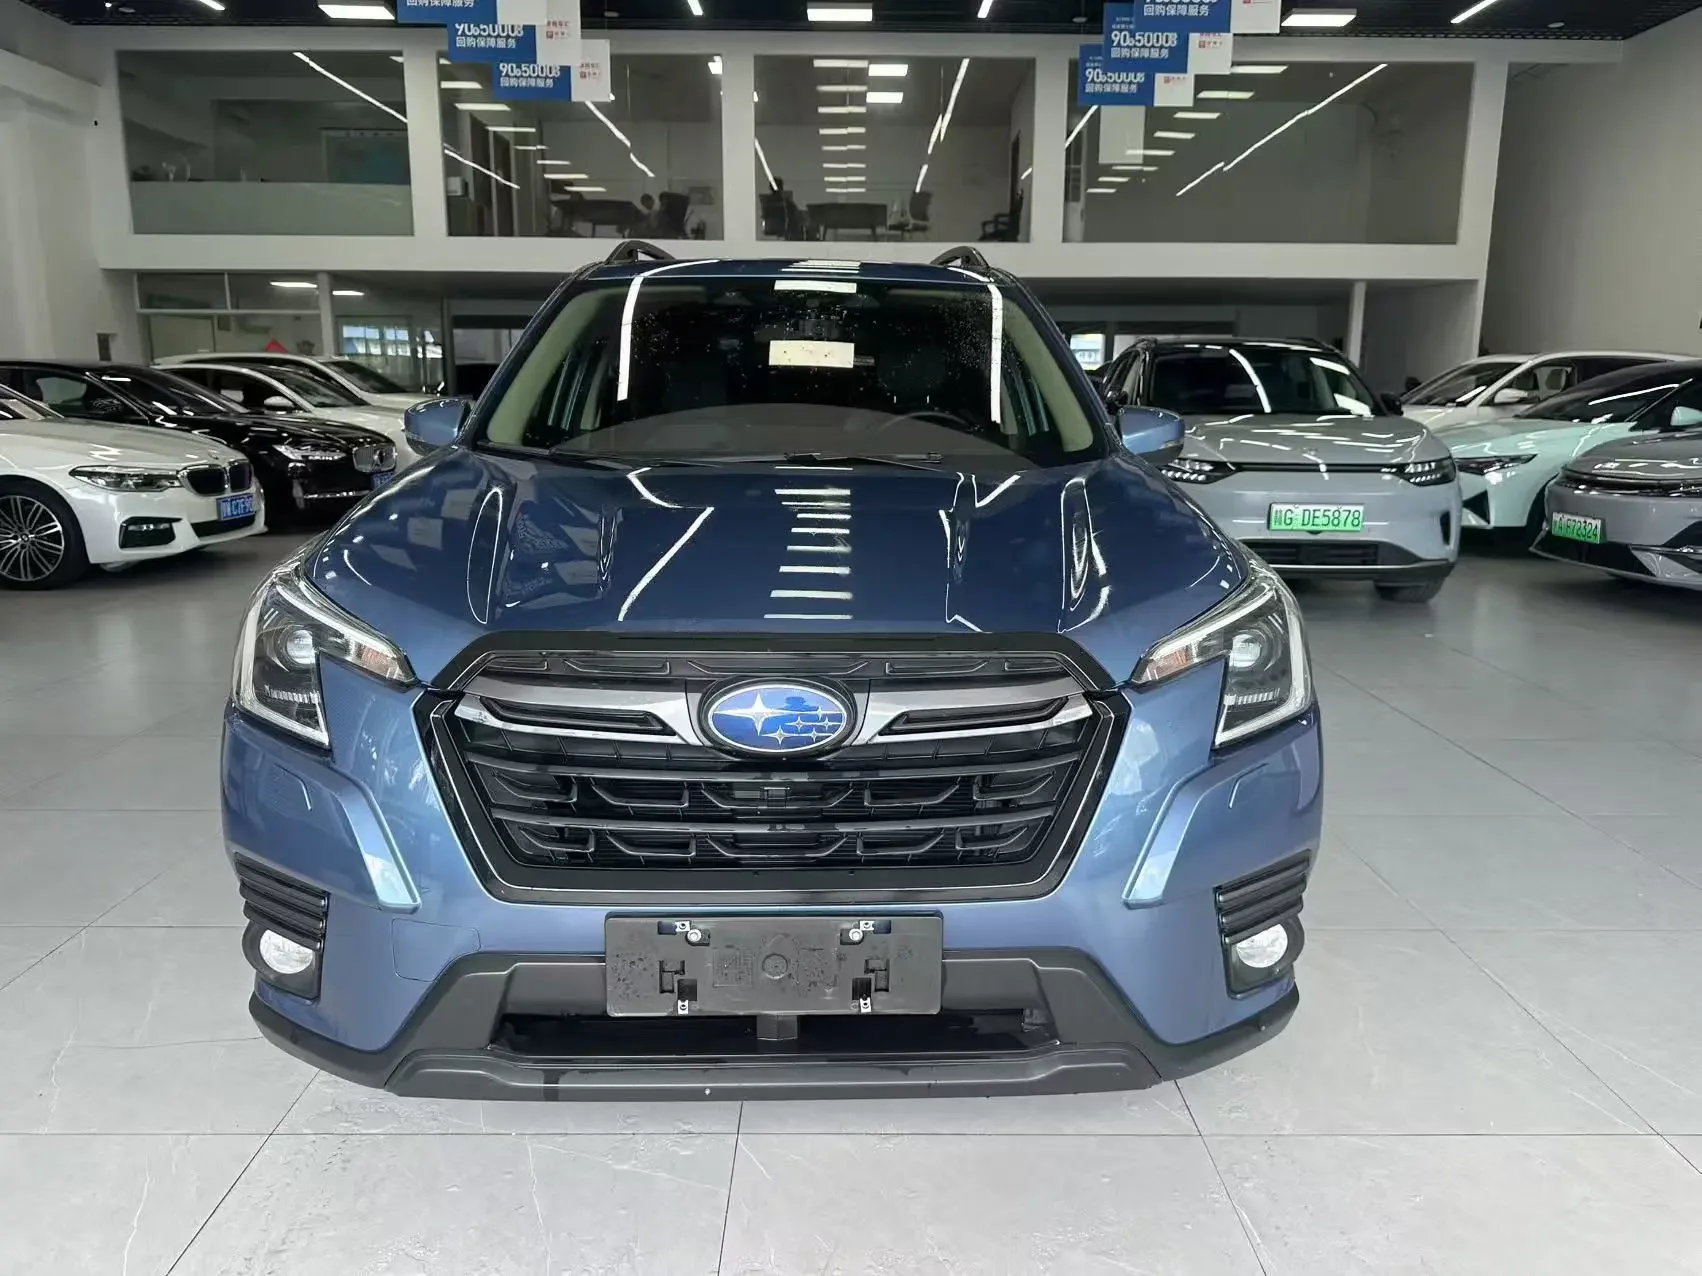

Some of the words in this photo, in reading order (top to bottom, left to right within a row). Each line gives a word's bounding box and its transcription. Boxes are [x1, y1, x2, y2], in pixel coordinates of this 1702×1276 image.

[1143, 4, 1209, 17] 回购保障服务
[456, 36, 516, 49] 回购保障服务
[1110, 47, 1169, 59] 回购保障服务
